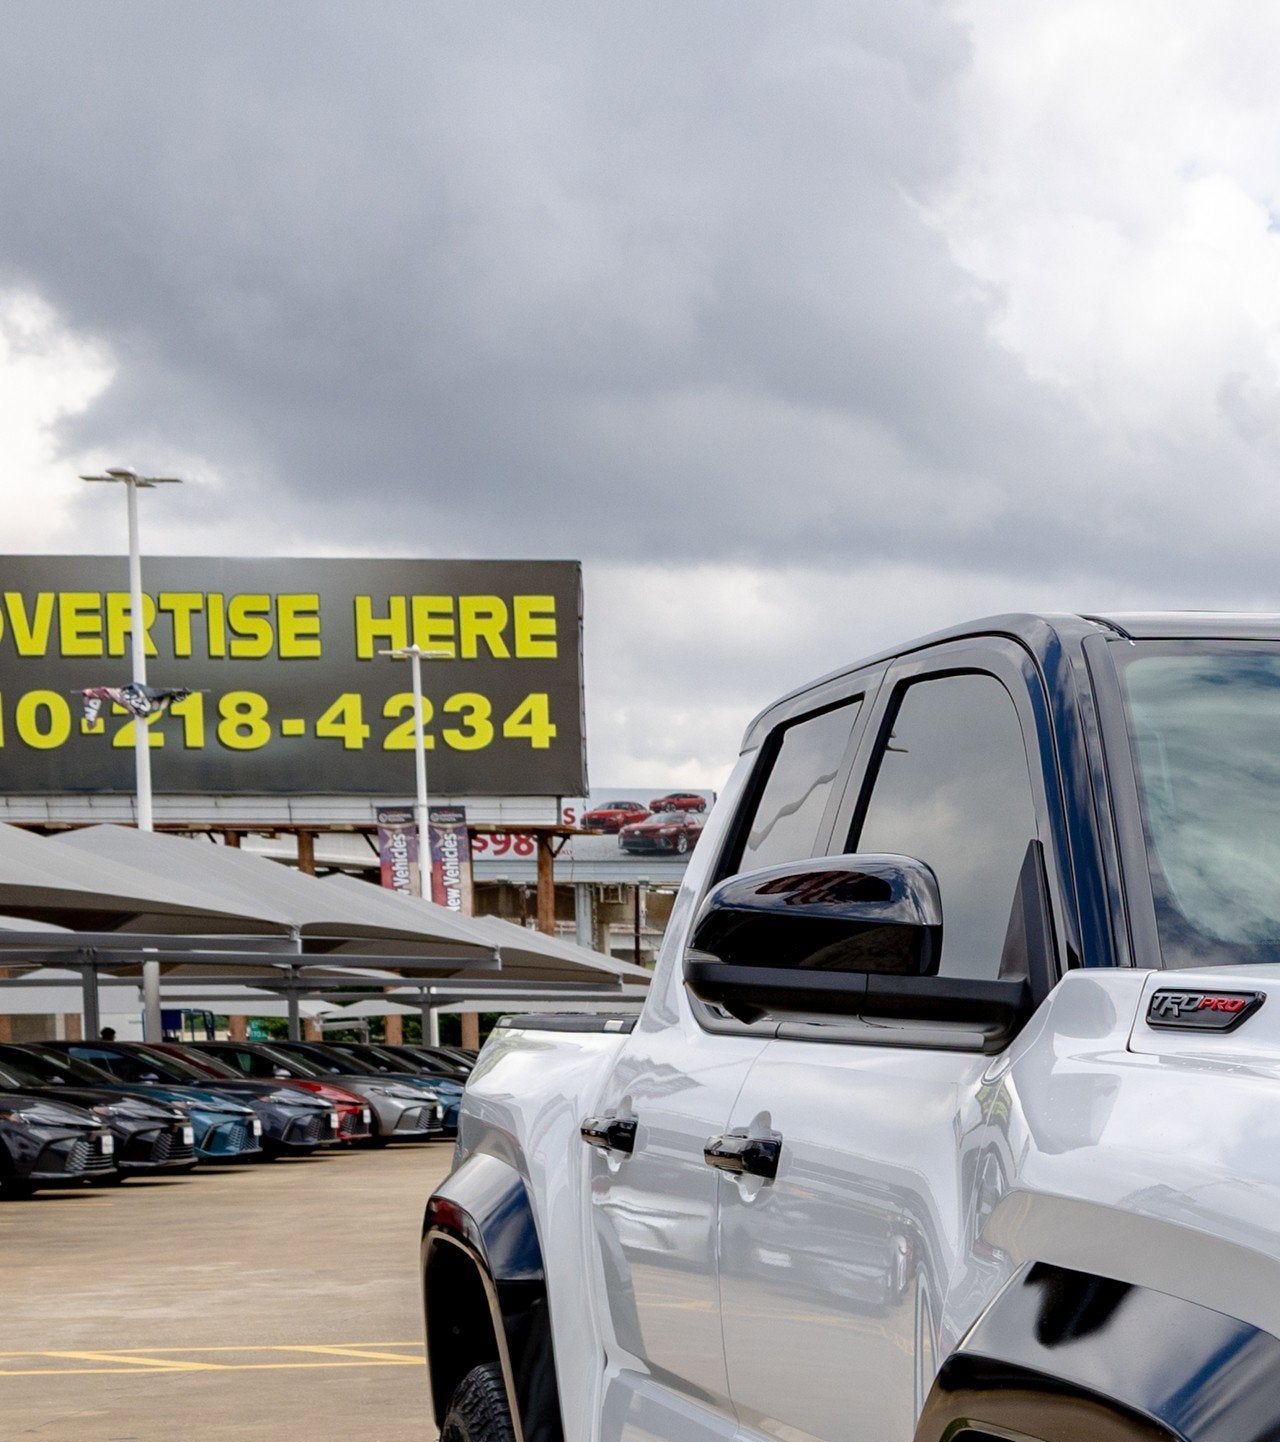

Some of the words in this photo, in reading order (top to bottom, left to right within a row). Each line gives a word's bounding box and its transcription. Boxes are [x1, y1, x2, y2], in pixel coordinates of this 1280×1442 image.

[0, 592, 321, 659] VERTISE
[354, 594, 558, 660] HERE
[0, 689, 558, 752] 0-218-4234
[391, 833, 410, 887] Vehicles
[441, 833, 460, 886] Vehicles
